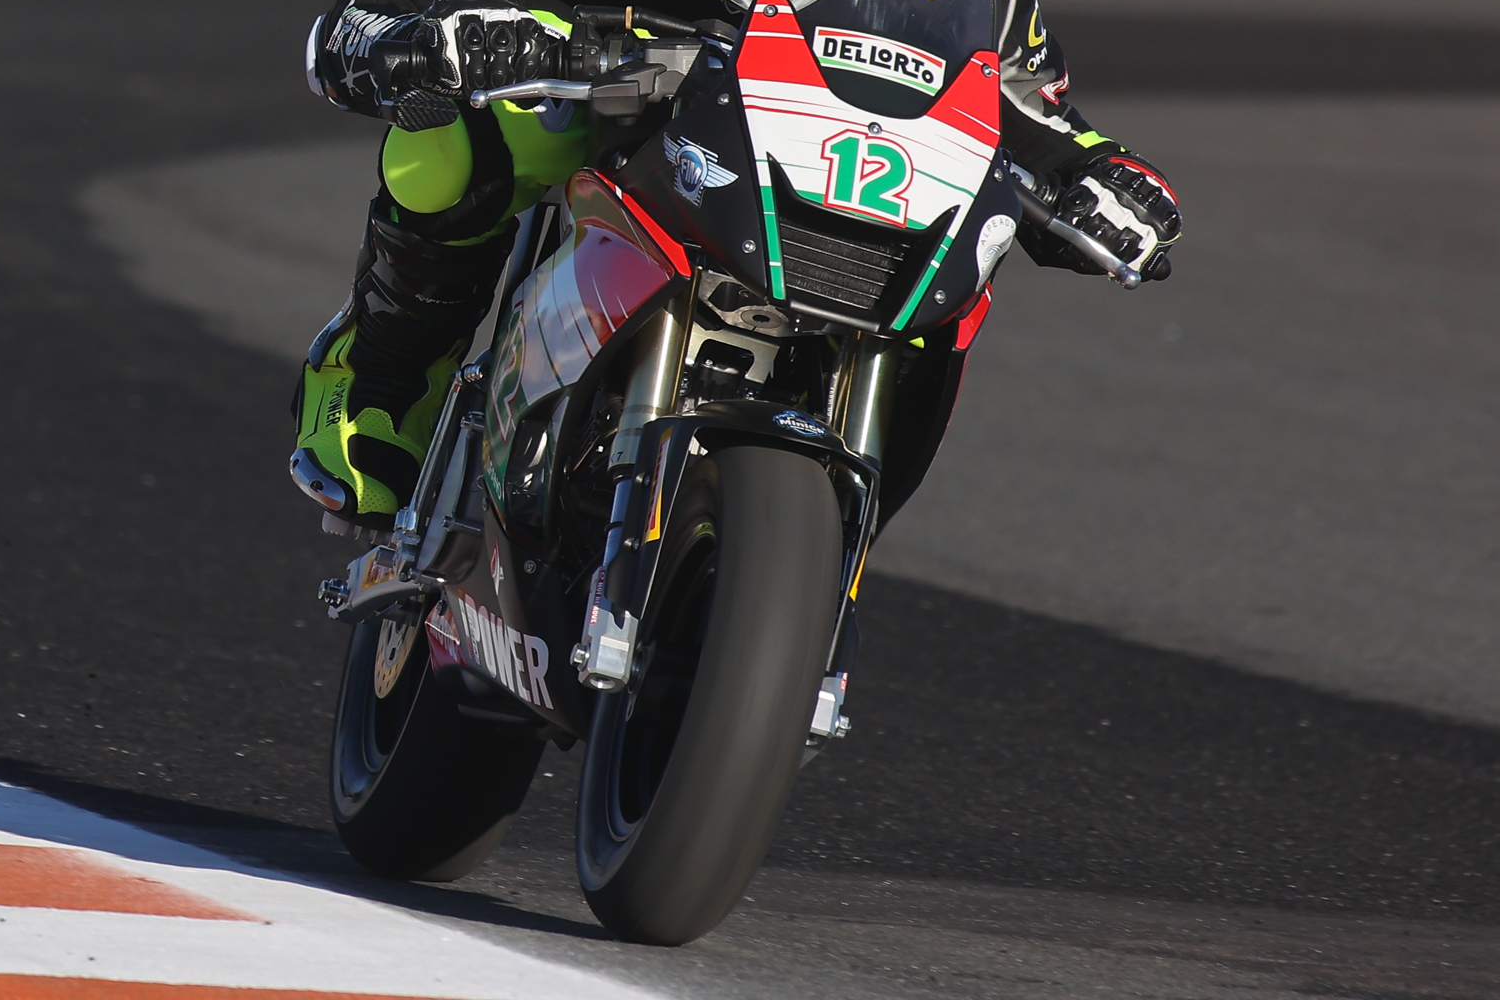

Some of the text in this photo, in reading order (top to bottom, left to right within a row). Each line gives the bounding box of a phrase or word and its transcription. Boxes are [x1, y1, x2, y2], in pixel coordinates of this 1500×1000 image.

[822, 37, 935, 85] DELLORTO
[680, 157, 702, 185] FIM
[824, 132, 911, 224] 12
[981, 219, 998, 246] ALPE
[326, 388, 346, 428] POWER
[464, 593, 554, 710] POWER
